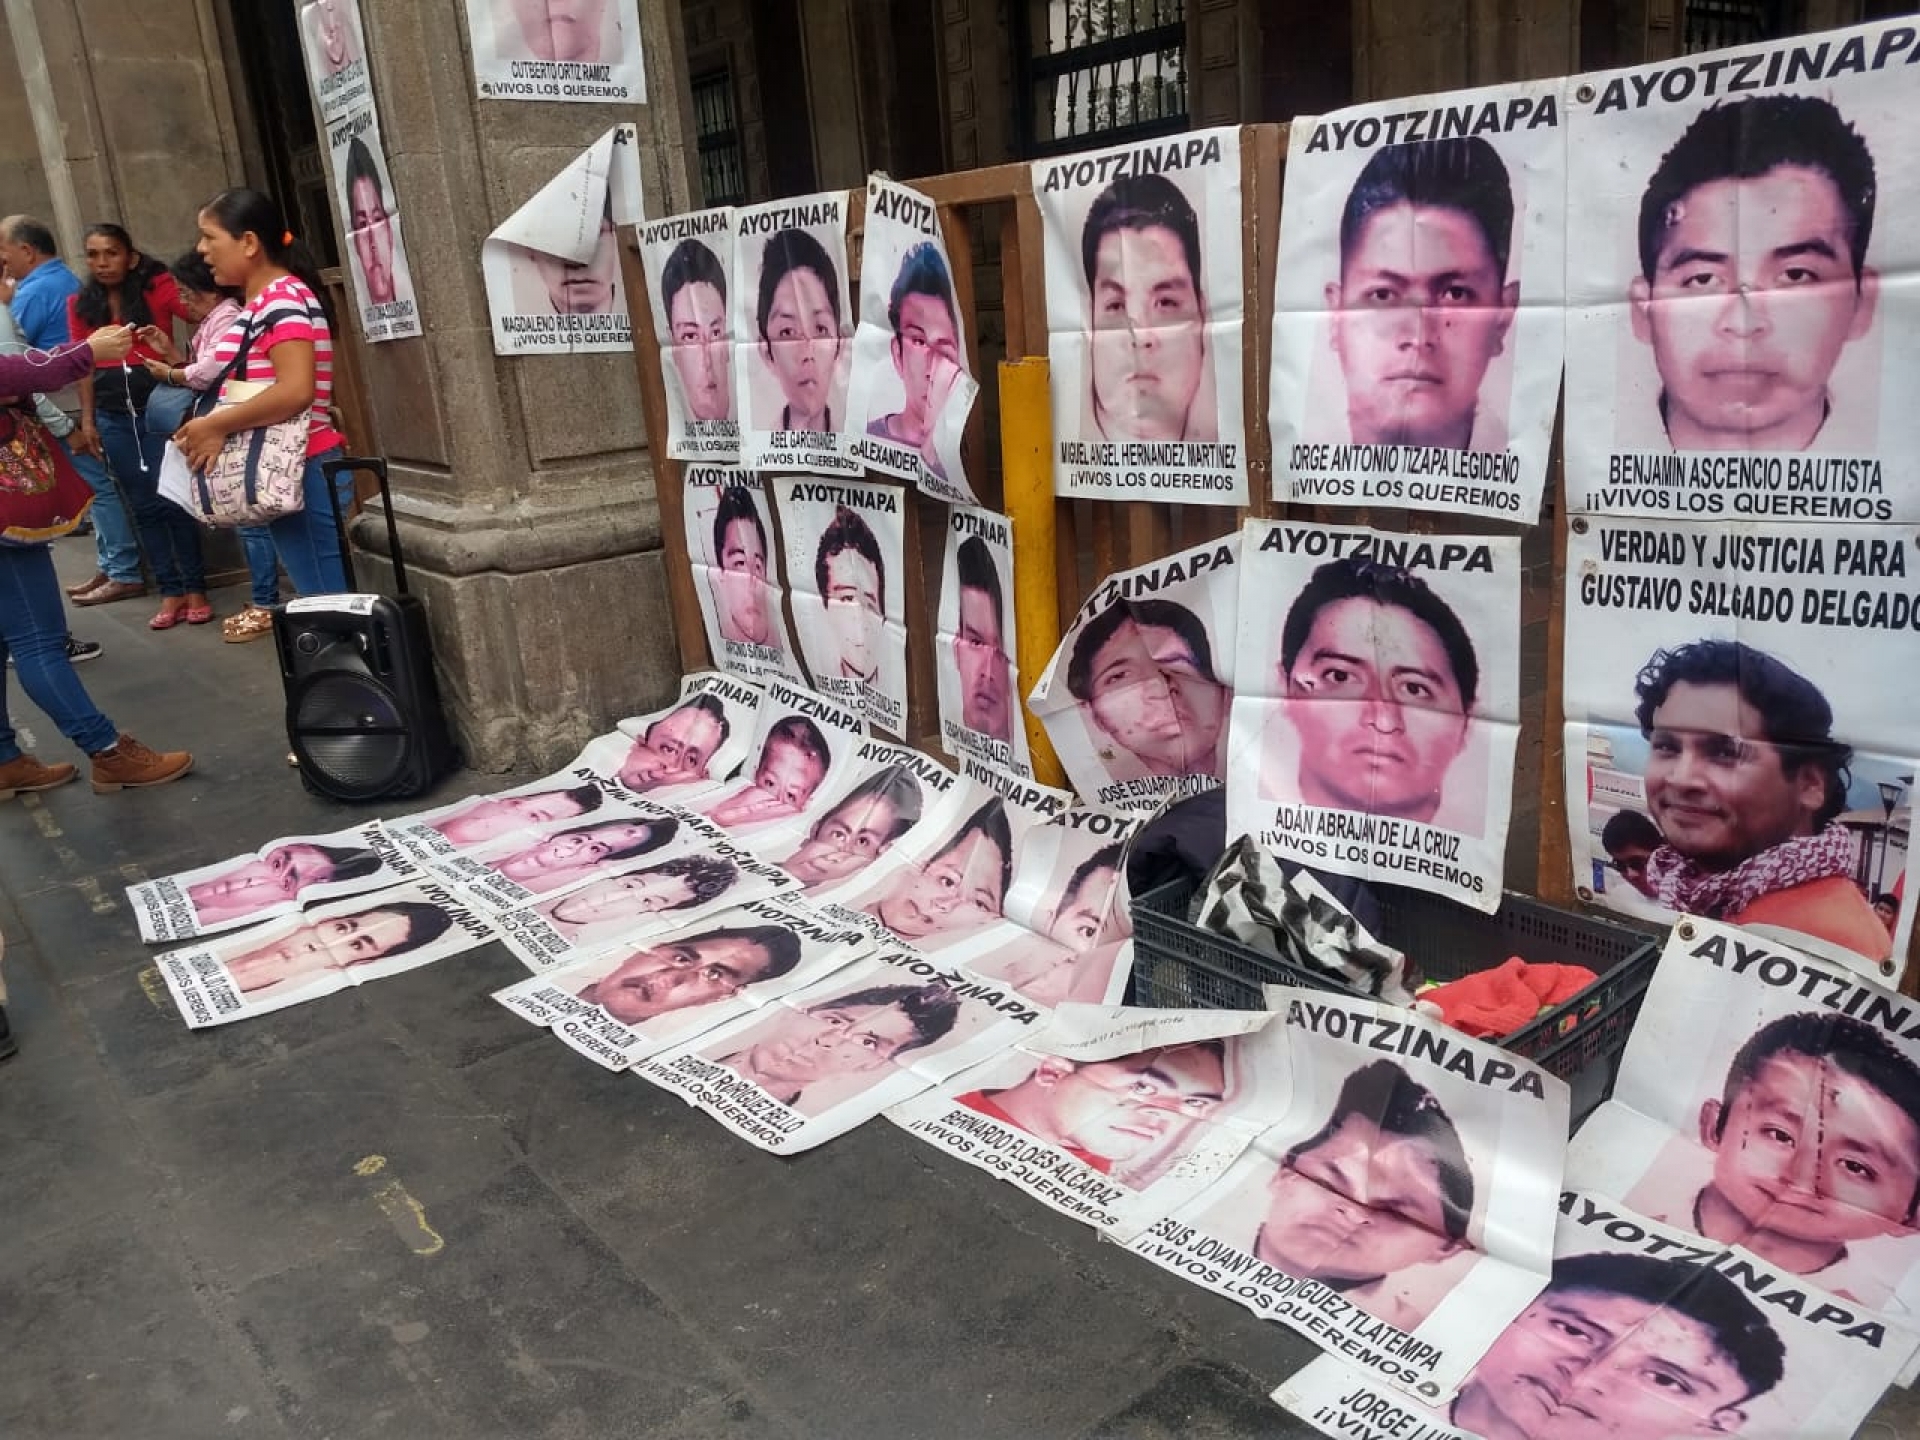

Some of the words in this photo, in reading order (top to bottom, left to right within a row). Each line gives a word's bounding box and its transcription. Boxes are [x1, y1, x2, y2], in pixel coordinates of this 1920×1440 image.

[537, 84, 560, 96] LOS
[563, 84, 628, 98] QUEREMOS
[1305, 95, 1558, 154] AYOTZINAPA
[1044, 135, 1221, 193] AYOTZINAPA
[645, 211, 728, 245] AYOTZINAPA
[738, 201, 840, 238] AYOTZINAPA
[859, 438, 918, 473] ALEXANDER
[1091, 443, 1120, 466] ANGEL
[1121, 442, 1185, 468] HERNANDEZ
[1187, 443, 1236, 469] MARTINEZ
[1290, 443, 1330, 471] JORGE
[1330, 444, 1398, 473] ANTONIO
[1402, 446, 1449, 476] TIZAPA
[1689, 456, 1782, 490] ASCENCIO
[1786, 458, 1883, 494] BAUTISTA
[790, 483, 897, 514] AYOTZINAPA
[1116, 472, 1147, 487] LOS
[1150, 473, 1234, 491] QUEREMOS
[1363, 479, 1404, 498] LOS
[1408, 481, 1521, 511] QUEREMOS
[1676, 491, 1724, 513] LOS
[1733, 493, 1893, 520] QUEREMOS
[1260, 526, 1495, 574] AYOTZINAPA
[1600, 528, 1685, 566] VERDAD
[1692, 534, 1708, 568] Y
[1712, 534, 1825, 575] JUSTICIA
[1834, 538, 1906, 578] PARA
[1581, 573, 1682, 613] GUSTAVO
[1689, 580, 1794, 623] SALGADO
[1097, 780, 1128, 805] JOSÉ
[1275, 803, 1314, 835] ADÁN
[1378, 820, 1401, 848] DE
[1403, 824, 1420, 850] LA
[1424, 829, 1460, 863] CRUZ
[1334, 843, 1369, 865] LOS
[1373, 850, 1484, 894] QUEREMOS
[1287, 1000, 1547, 1102] AYOTZINAPA
[940, 1109, 1015, 1150] BERNARDO
[1051, 1161, 1124, 1207] ALCARAZ
[972, 1149, 1013, 1172] LOS
[1011, 1165, 1120, 1227] QUEREMOS
[1187, 1236, 1262, 1279] JOVANY
[1346, 1307, 1445, 1373] TLATEMPA
[1222, 1280, 1274, 1311] LOS
[1274, 1300, 1421, 1387] QUEREMOS
[1339, 1387, 1418, 1438] JORGE
